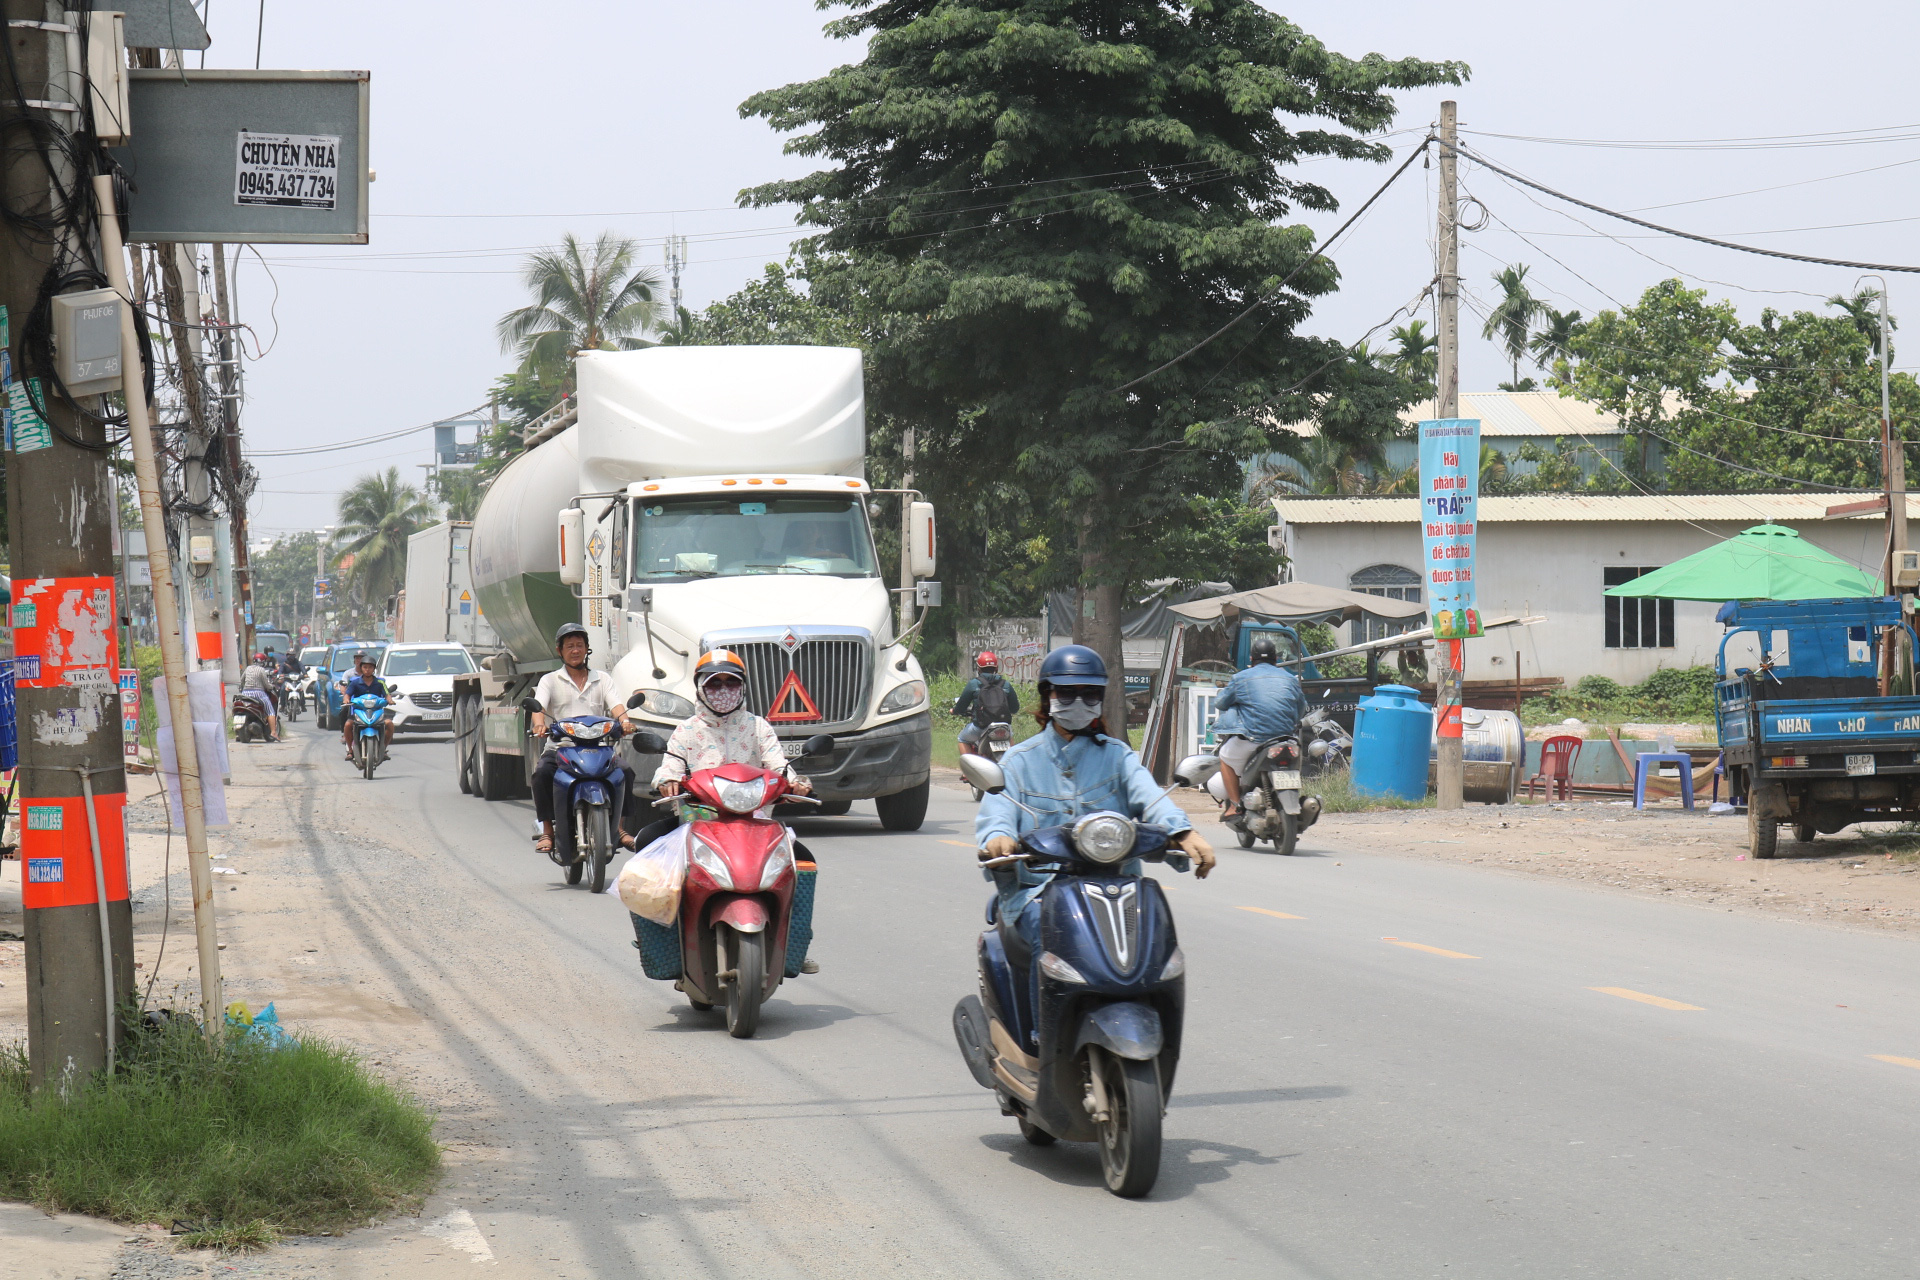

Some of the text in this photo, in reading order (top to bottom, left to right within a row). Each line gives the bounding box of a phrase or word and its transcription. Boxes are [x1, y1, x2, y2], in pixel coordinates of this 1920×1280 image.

[241, 138, 336, 168] CHUYỂN NHÀ
[239, 171, 335, 198] 0945.437.734
[104, 358, 118, 372] 48
[1443, 451, 1459, 467] Hãy
[1433, 475, 1455, 491] phân
[1426, 521, 1444, 537] thải
[1445, 522, 1457, 538] tại
[1432, 542, 1444, 560] để
[1432, 569, 1454, 585] được
